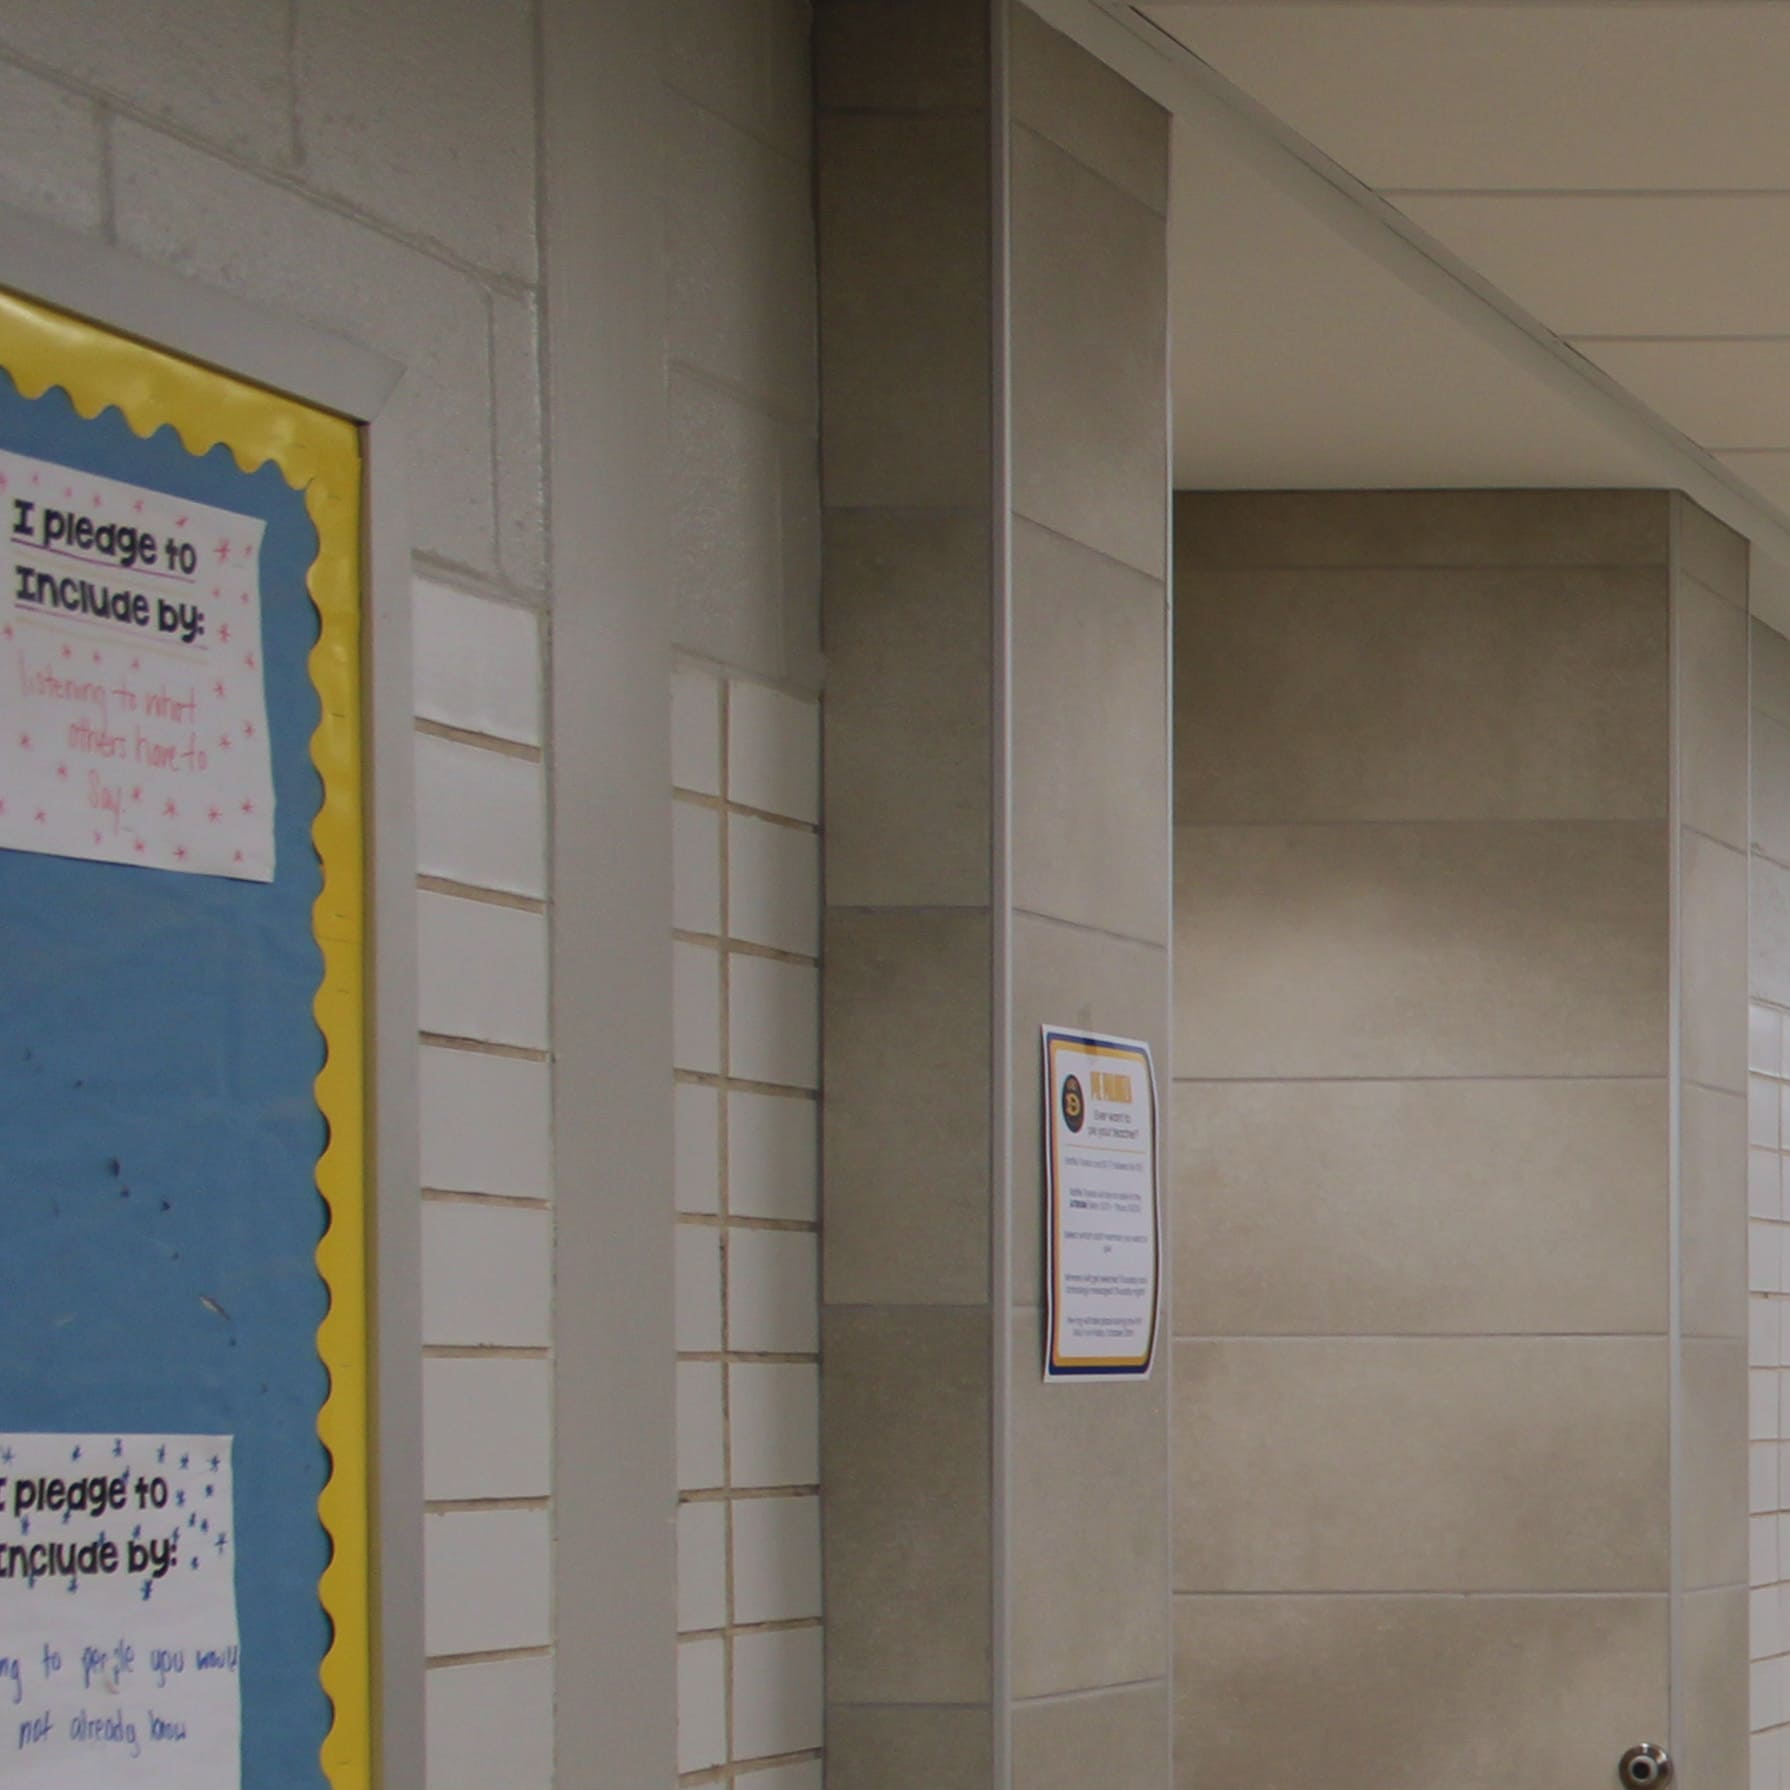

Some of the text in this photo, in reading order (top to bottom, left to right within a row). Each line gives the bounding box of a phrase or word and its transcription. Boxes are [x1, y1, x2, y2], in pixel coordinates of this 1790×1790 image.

[13, 499, 197, 575] I pledge to
[15, 565, 205, 643] Include by:
[111, 676, 137, 711] to
[69, 718, 208, 772] others have to
[13, 1475, 127, 1518] pledge
[134, 1475, 169, 1510] to
[126, 1538, 178, 1579] by:
[43, 1642, 62, 1680] to
[150, 1648, 185, 1689] you
[18, 1709, 54, 1750] not
[69, 1707, 142, 1759] already
